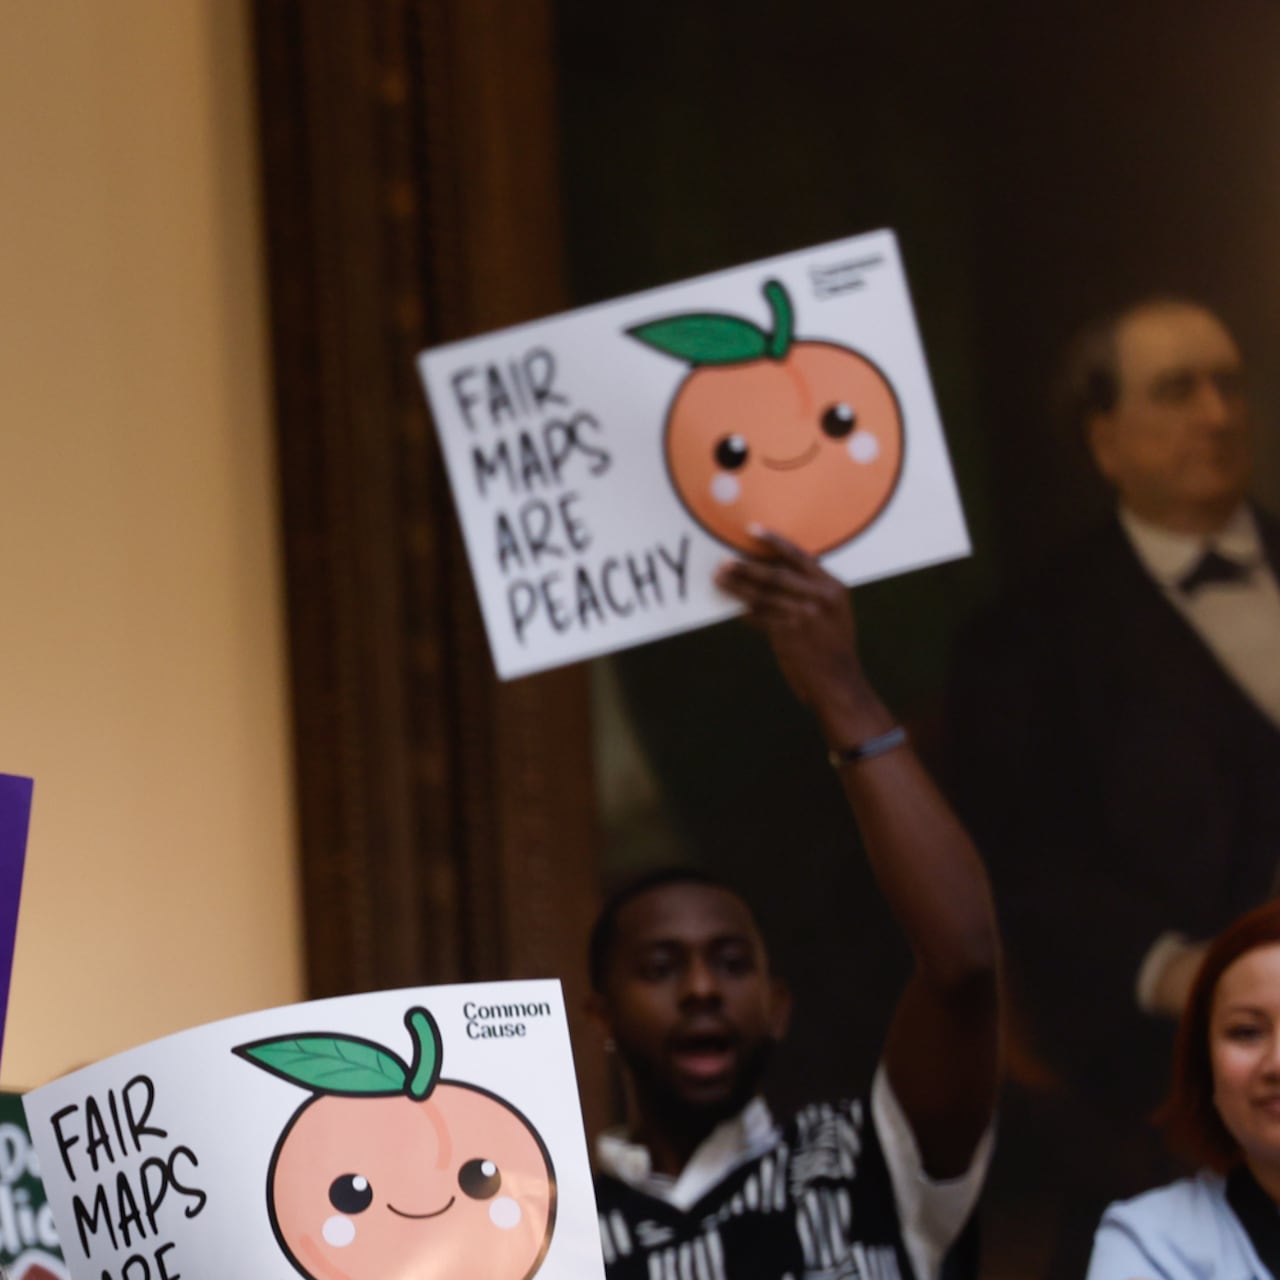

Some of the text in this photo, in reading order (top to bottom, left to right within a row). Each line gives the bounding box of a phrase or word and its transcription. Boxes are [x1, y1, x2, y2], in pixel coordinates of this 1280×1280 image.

[449, 347, 569, 433] FAIR
[470, 411, 613, 498] MAPS
[494, 491, 593, 576] ARE
[505, 533, 693, 647] PEACHY
[463, 1002, 551, 1020] Common
[466, 1020, 526, 1040] Cause
[50, 1075, 167, 1182] FAIR
[72, 1146, 207, 1259] MAPS
